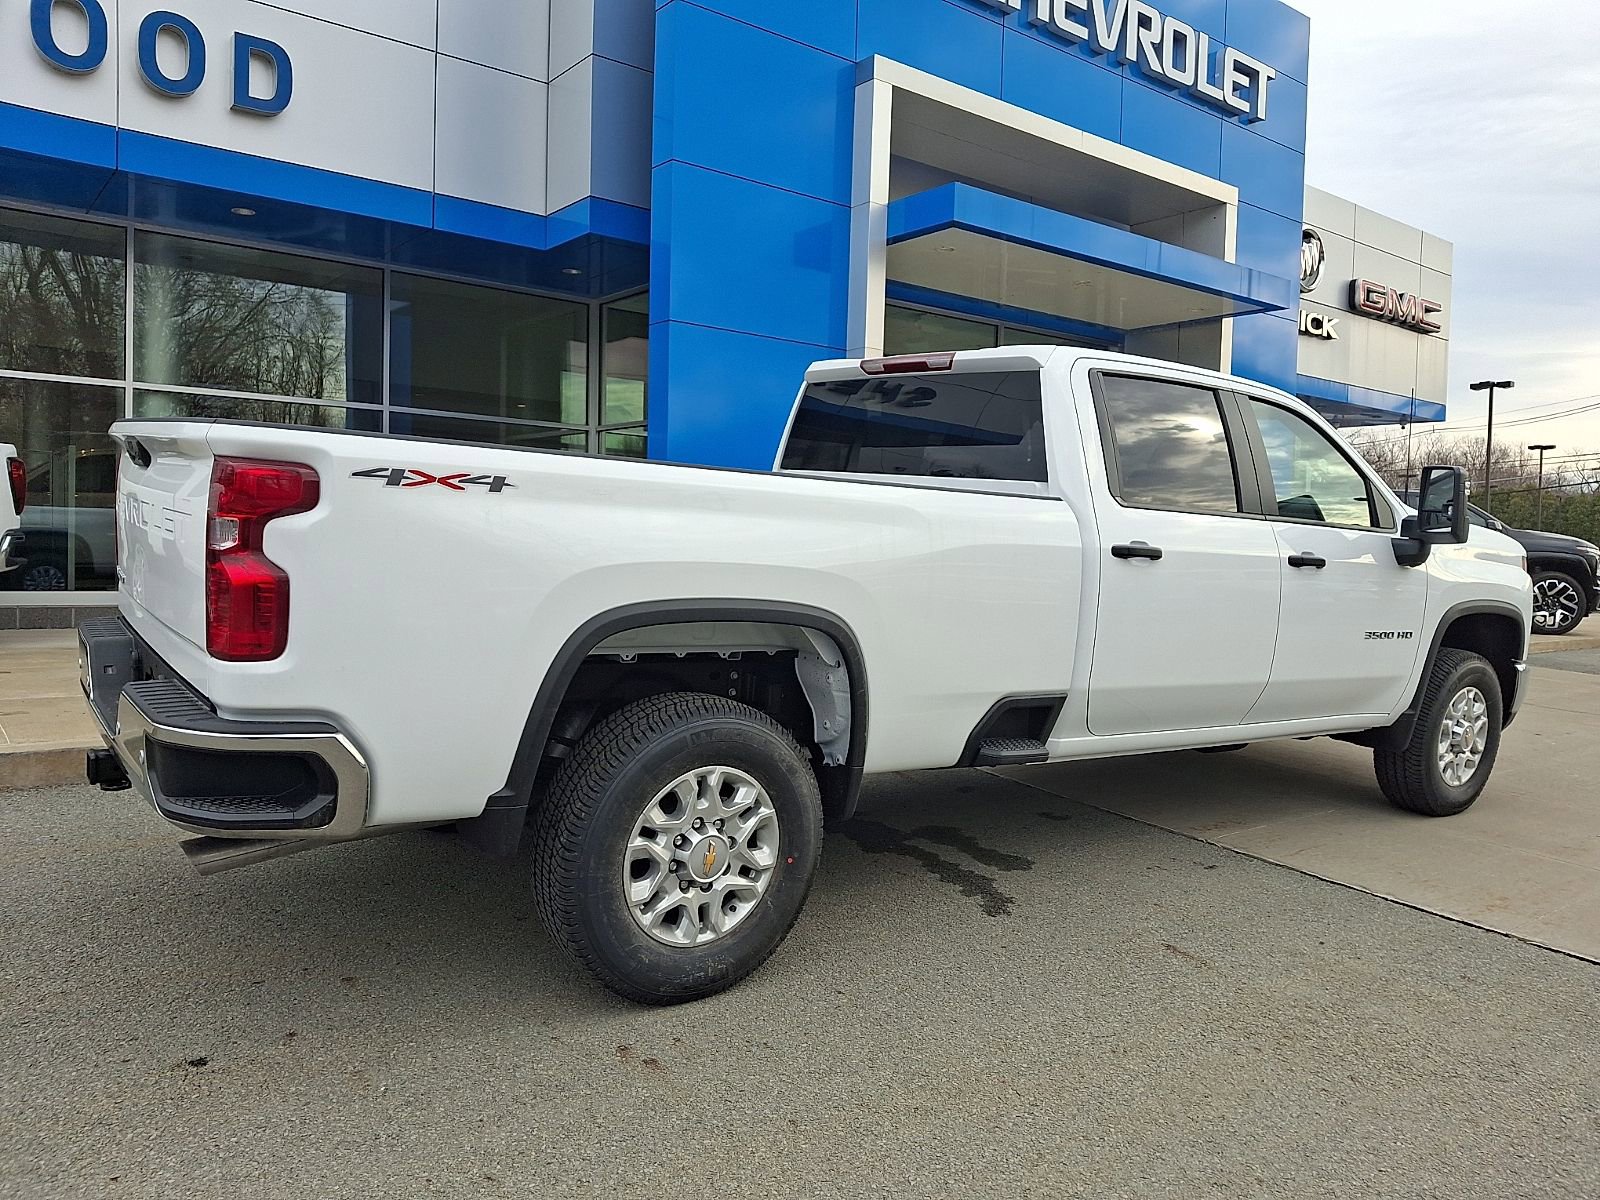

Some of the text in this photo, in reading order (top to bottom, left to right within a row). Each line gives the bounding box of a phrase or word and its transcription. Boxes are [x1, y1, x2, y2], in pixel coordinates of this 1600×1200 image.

[990, 0, 1276, 123] EVROLET
[1354, 278, 1442, 334] GMC
[1364, 631, 1414, 640] 3500 HD
